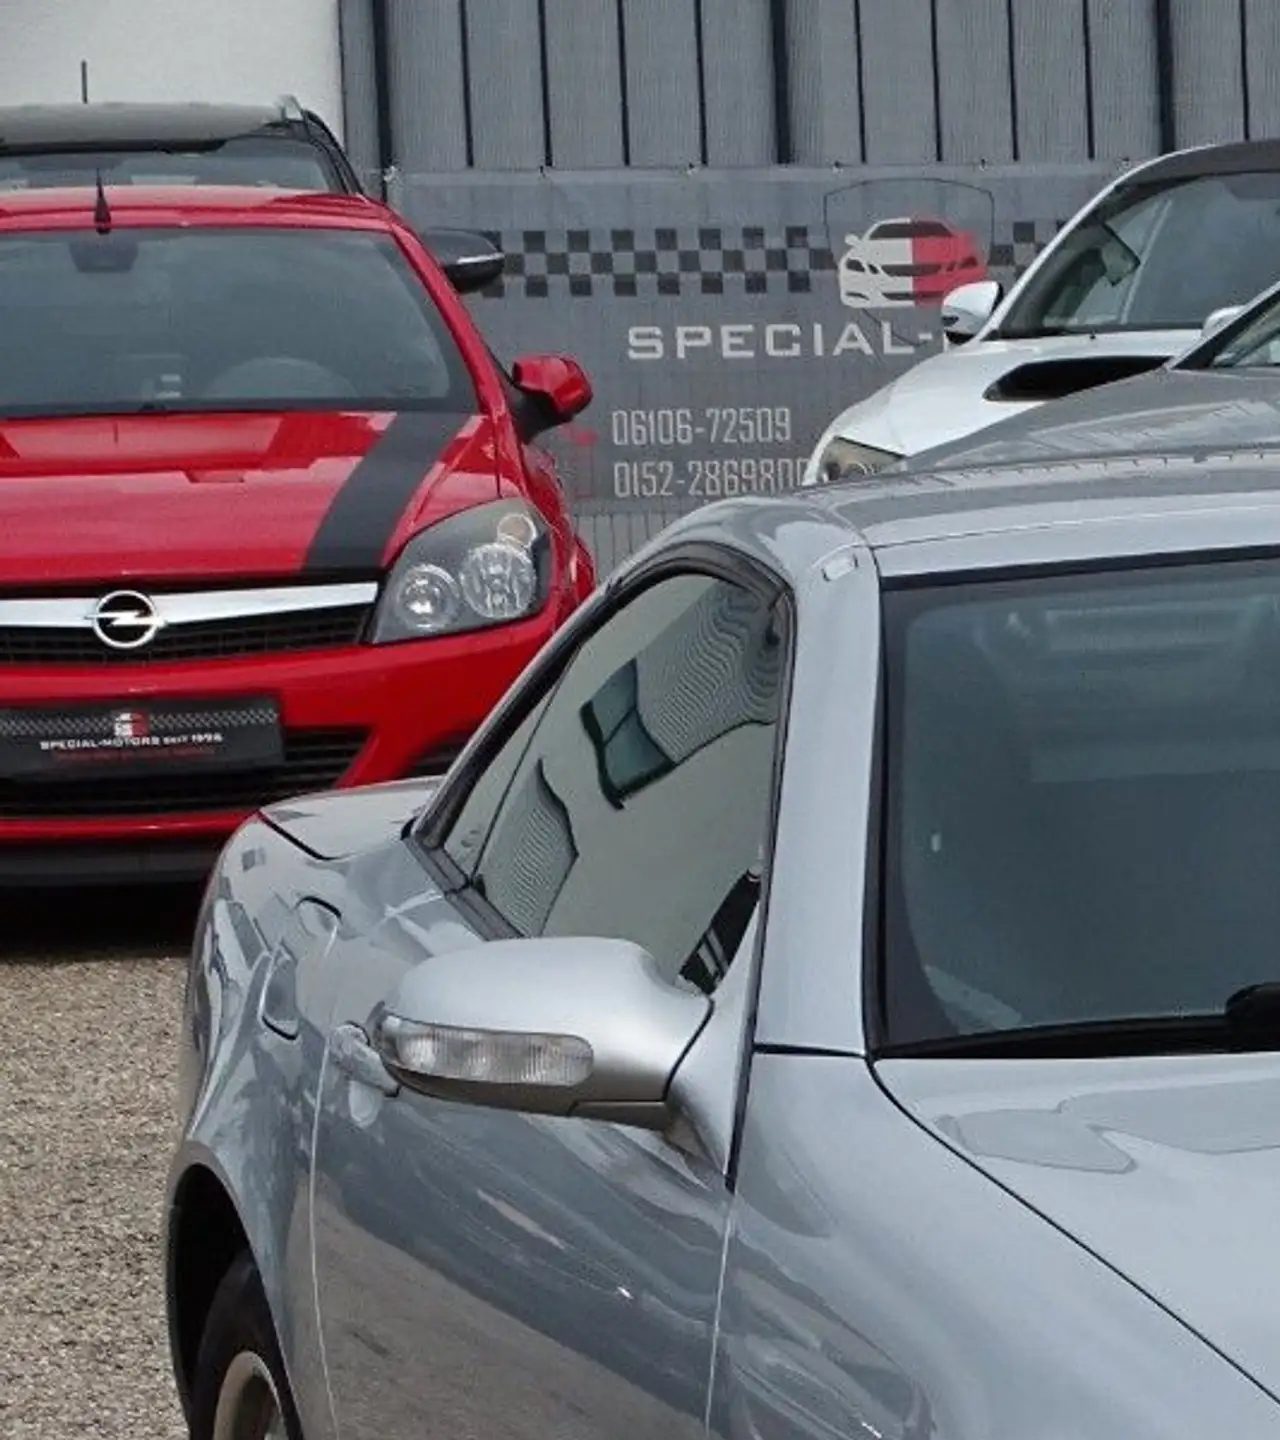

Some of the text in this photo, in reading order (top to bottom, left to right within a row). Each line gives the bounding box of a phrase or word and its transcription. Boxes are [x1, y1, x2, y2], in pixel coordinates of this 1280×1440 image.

[628, 323, 949, 360] SPECIAL-
[612, 407, 792, 446] 06106-72509
[40, 736, 160, 750] SPECIAL-MOTORS
